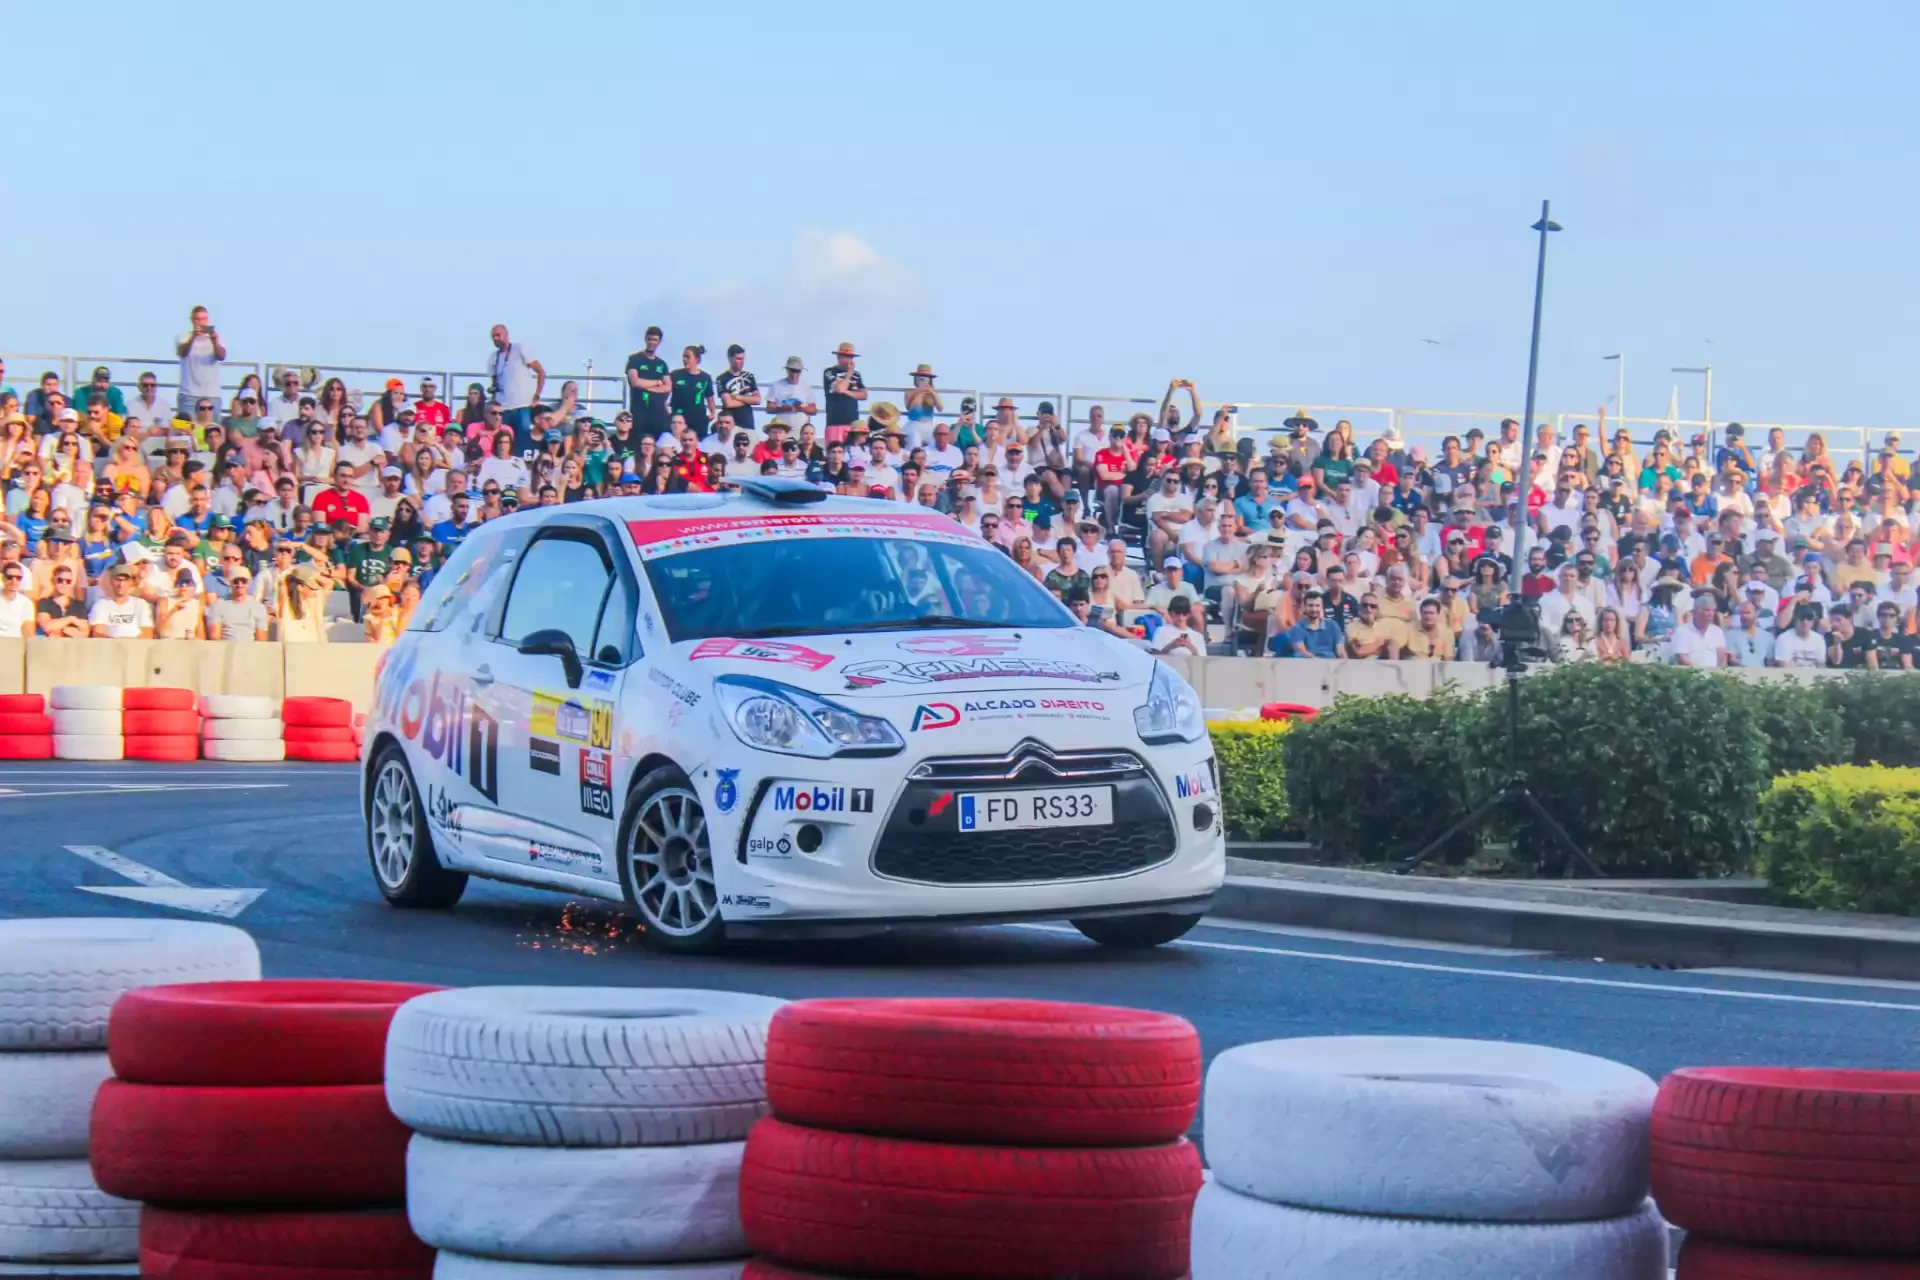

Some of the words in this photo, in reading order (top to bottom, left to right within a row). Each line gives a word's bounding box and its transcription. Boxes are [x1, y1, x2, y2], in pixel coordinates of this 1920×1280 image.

[964, 699, 1036, 712] ALCADO
[1039, 699, 1105, 711] DIREITO
[592, 699, 612, 749] 90
[774, 787, 844, 811] Mobil
[987, 798, 1018, 822] FD
[1033, 794, 1094, 819] RS33
[750, 837, 774, 852] galp
